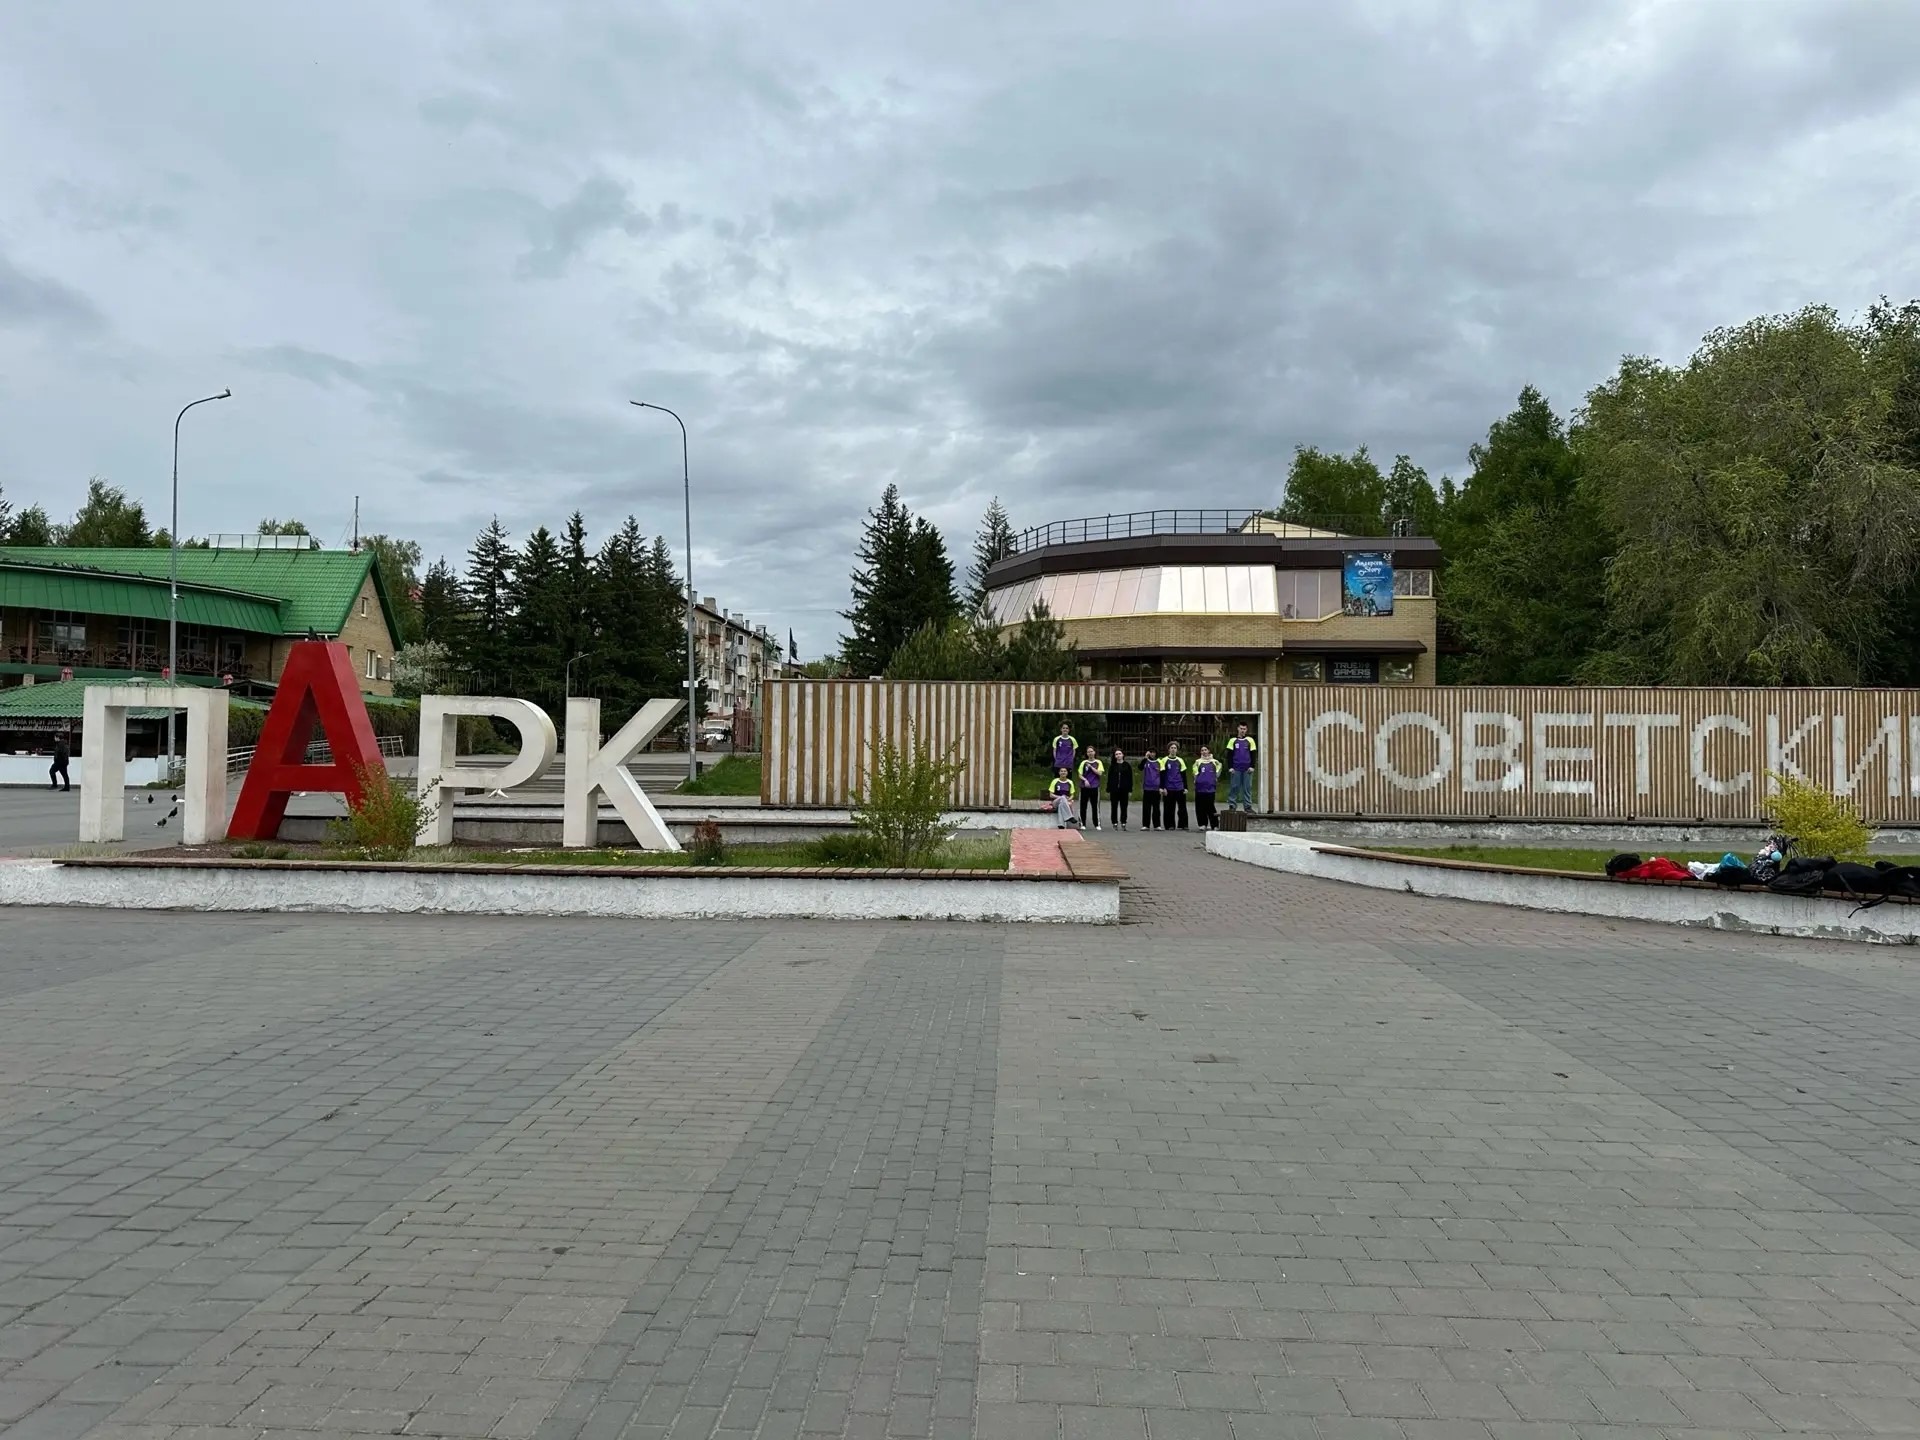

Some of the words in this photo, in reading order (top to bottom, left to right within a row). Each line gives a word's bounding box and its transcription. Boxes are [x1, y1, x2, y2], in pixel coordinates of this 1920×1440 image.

[1333, 668, 1371, 676] GAMERS
[79, 640, 687, 851] ПАРК
[1305, 710, 1920, 797] СОВЕТСКИ
